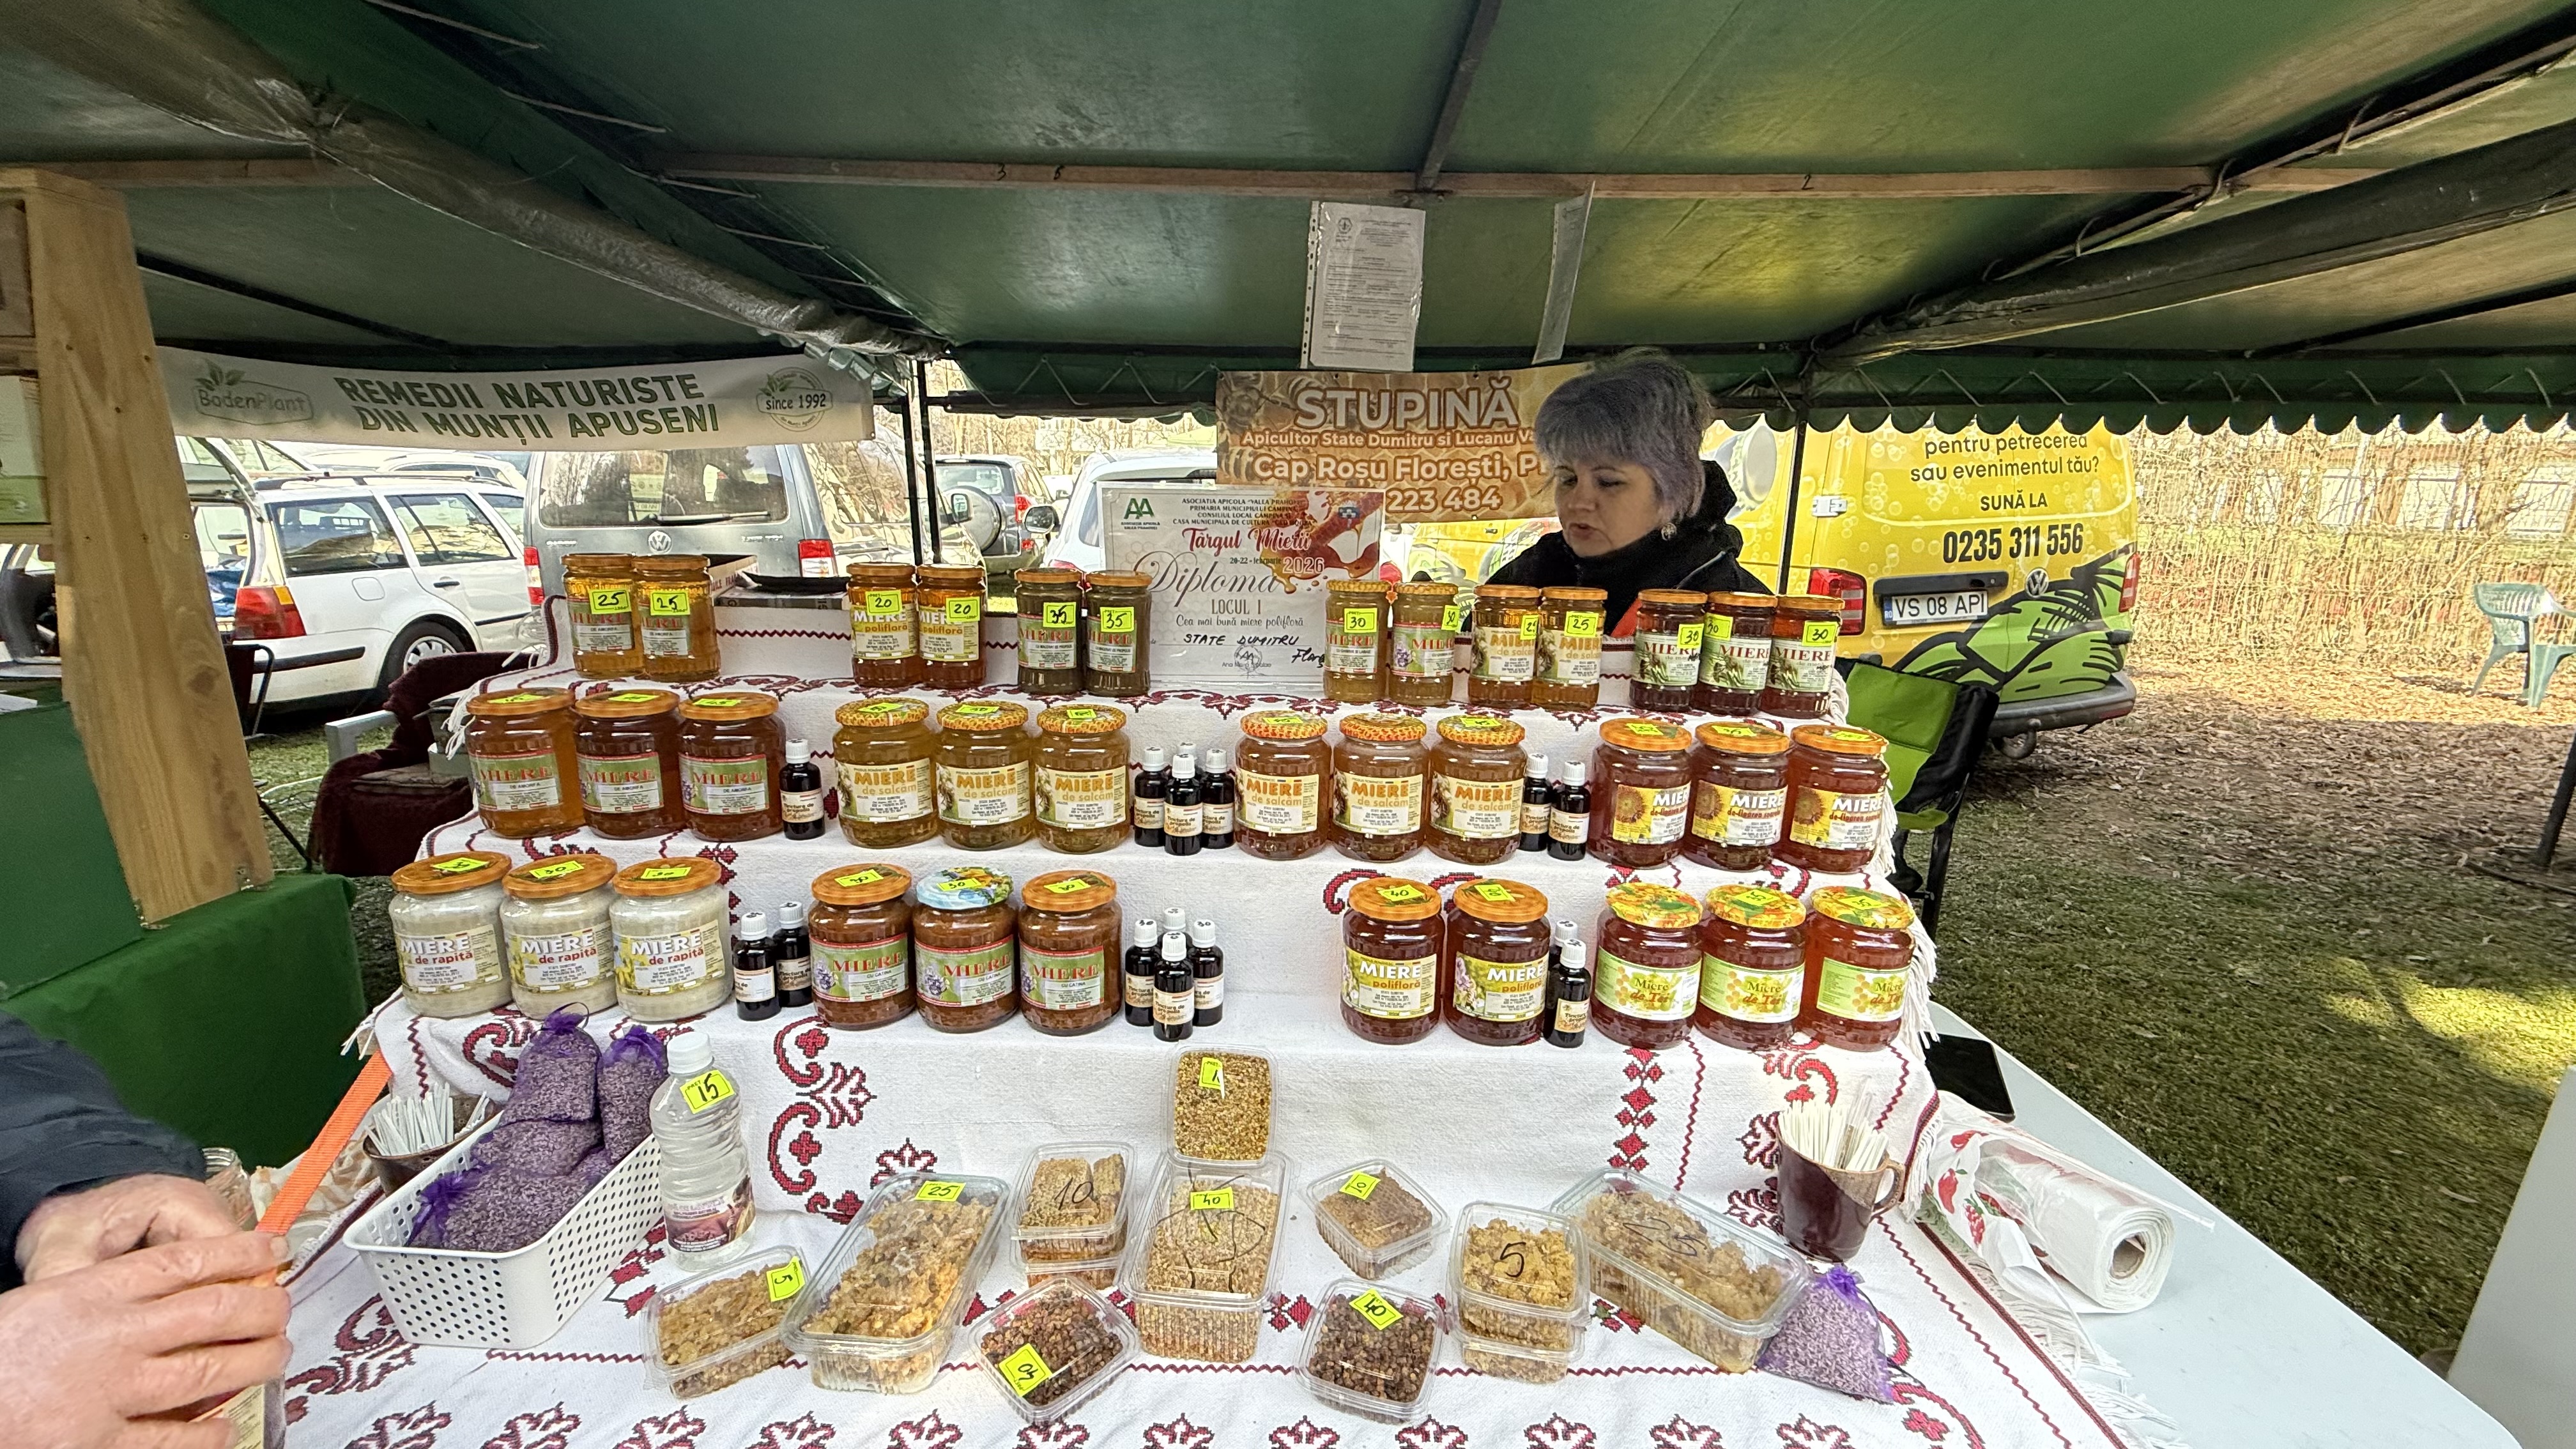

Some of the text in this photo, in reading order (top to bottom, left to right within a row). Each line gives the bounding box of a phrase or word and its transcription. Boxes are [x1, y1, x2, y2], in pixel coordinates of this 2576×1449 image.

[334, 374, 704, 409] REMEDII NATURISTE
[198, 388, 307, 412] BodenPlant
[766, 394, 825, 410] since 1992
[1294, 377, 1519, 429] STUPINĂ
[353, 404, 719, 445] DIN MUNȚII APUSENI
[1243, 431, 1514, 447] Apicultor State Dumitru si Lucanu
[1925, 434, 2087, 459] pentru petrecerea
[1254, 452, 1510, 484] Cap Roșu Florești,
[1910, 456, 2099, 482] sau evenimentul tău?
[1387, 488, 1501, 511] 223 484
[1980, 490, 2048, 511] SUNĂ LA
[1182, 528, 1312, 556] Târgul Mierii
[1943, 523, 2084, 564] 0235 311 556
[1283, 556, 1324, 574] 2026
[1133, 551, 1279, 608] Diploma
[597, 592, 625, 606] 25
[656, 595, 678, 610] 25
[875, 597, 892, 608] 20
[1211, 599, 1261, 615] LOCUL I
[1895, 598, 1919, 618] VS
[1927, 597, 1947, 616] 08
[1954, 593, 1984, 615] API
[954, 604, 971, 615] 20
[1050, 605, 1067, 624] 35
[1107, 612, 1127, 629] 35
[1176, 615, 1193, 626] Cea
[1198, 617, 1212, 625] mai
[1216, 617, 1236, 626] bună
[1241, 617, 1262, 626] miere
[1350, 617, 1366, 628] 30
[1573, 619, 1590, 631] 25
[1183, 634, 1300, 646] STATE DUMITRU
[1684, 631, 1699, 644] 30
[1813, 629, 1829, 641] 30
[1775, 647, 1832, 661] MIERE
[586, 769, 656, 784] MIERE
[693, 771, 764, 785] MIERE
[854, 768, 916, 786] MIERE
[956, 771, 1016, 788] MIERE
[1055, 776, 1113, 792] MIERE
[879, 784, 917, 795] salcâm
[981, 787, 1016, 797] salcâm
[1246, 778, 1302, 796] MIERE
[1351, 781, 1409, 797] MIERE
[1455, 786, 1513, 802] MIERE
[1078, 792, 1114, 802] salcâm
[1252, 794, 1302, 806] de salcâm
[1357, 796, 1408, 808] de salcâm
[1730, 795, 1784, 809] MIERE
[1832, 798, 1883, 812] MIERE
[1462, 801, 1511, 811] de salcâm
[400, 936, 470, 954] MIERE
[521, 931, 595, 955] MIERE
[631, 931, 703, 955] MIERE
[415, 955, 429, 964] de
[539, 954, 555, 964] de
[649, 955, 664, 965] de
[833, 953, 903, 972] MIERE
[944, 953, 1011, 977] MIERE
[1032, 963, 1100, 979] MIERE
[1360, 960, 1420, 979] MIERE
[1487, 964, 1544, 982] MIERE
[1634, 977, 1669, 991] Miere
[1747, 981, 1781, 993] Miere
[1874, 982, 1903, 992] Miere
[1630, 992, 1645, 1001] de
[1742, 994, 1758, 1004] de
[1870, 995, 1885, 1004] de
[697, 1073, 719, 1103] 15
[925, 1185, 952, 1197] 25
[1054, 1176, 1095, 1211] 10
[1350, 1181, 1367, 1195] 10
[1202, 1194, 1221, 1206] 40
[1499, 1241, 1526, 1278] 5
[774, 1275, 793, 1284] 5
[1364, 1299, 1387, 1317] 40
